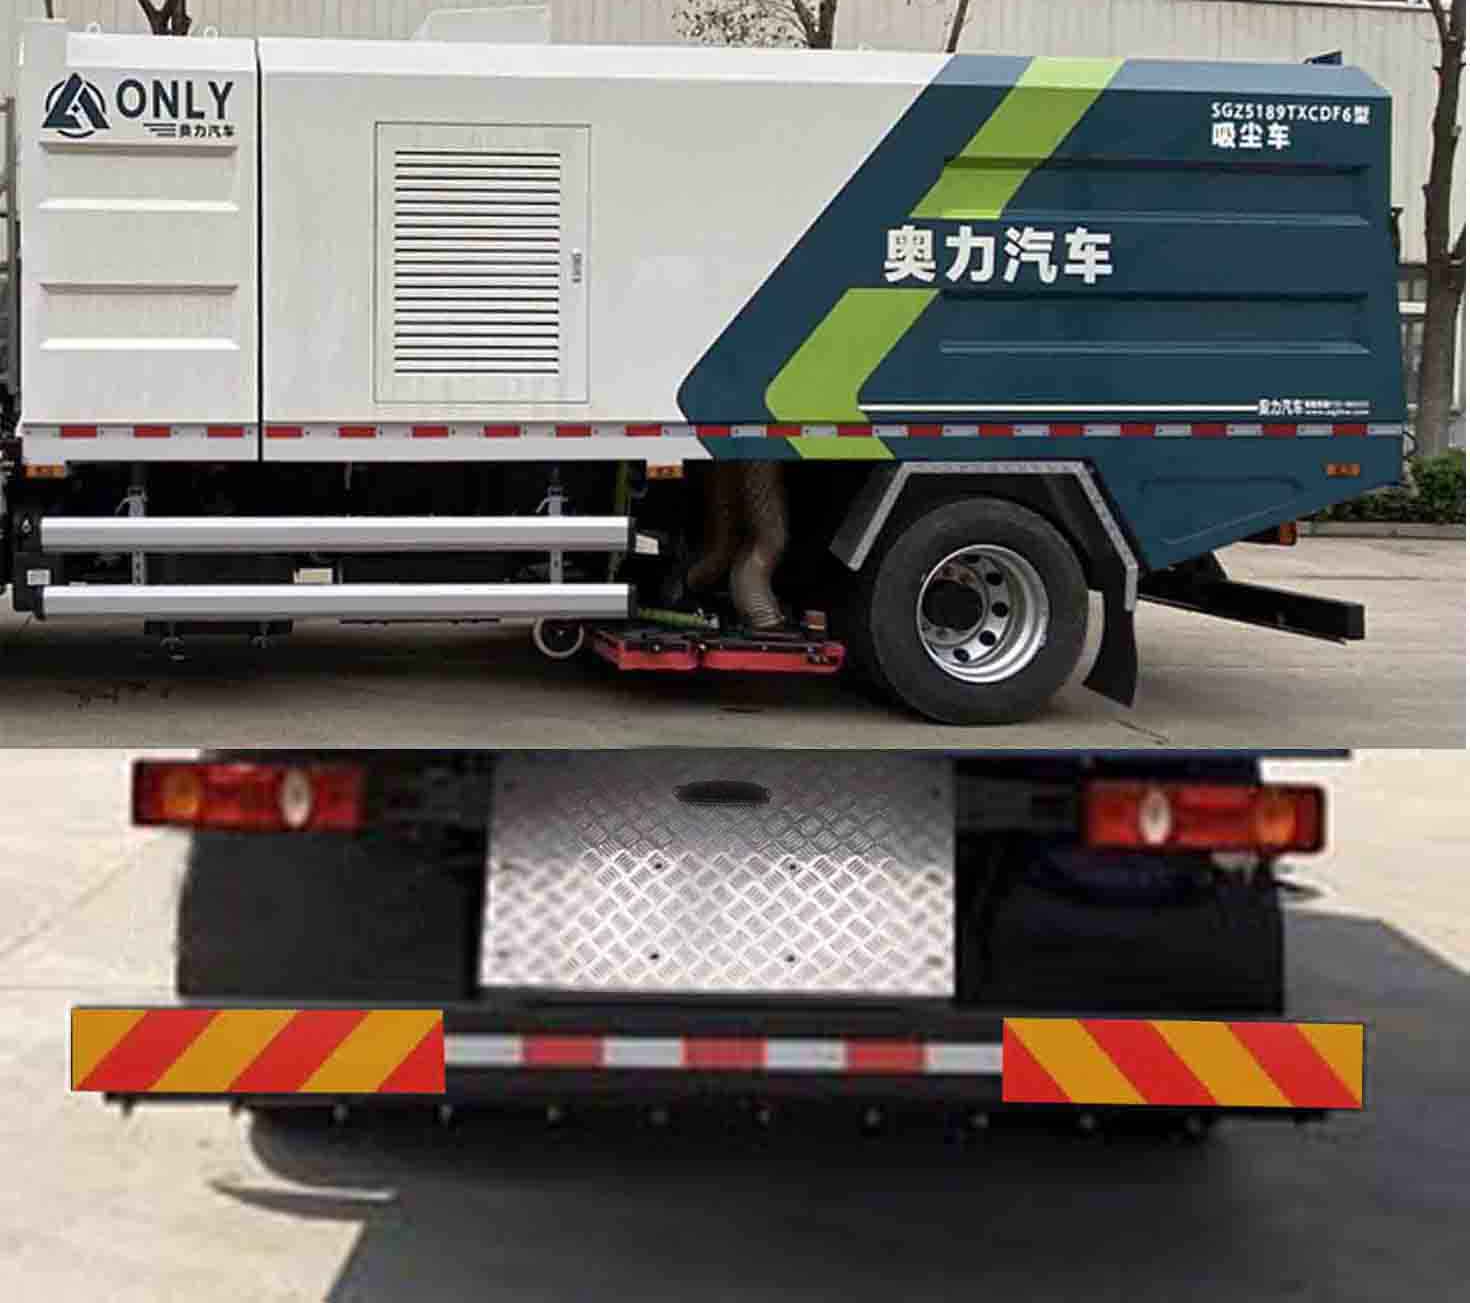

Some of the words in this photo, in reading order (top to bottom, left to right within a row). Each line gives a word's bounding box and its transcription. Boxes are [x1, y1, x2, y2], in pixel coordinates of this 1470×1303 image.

[116, 78, 234, 119] ONLY
[1211, 102, 1370, 125] SGZ5189TXCDF6型
[179, 124, 236, 138] 奥力汽车
[1211, 122, 1291, 150] 吸尘车
[884, 225, 1113, 284] 奥力汽车
